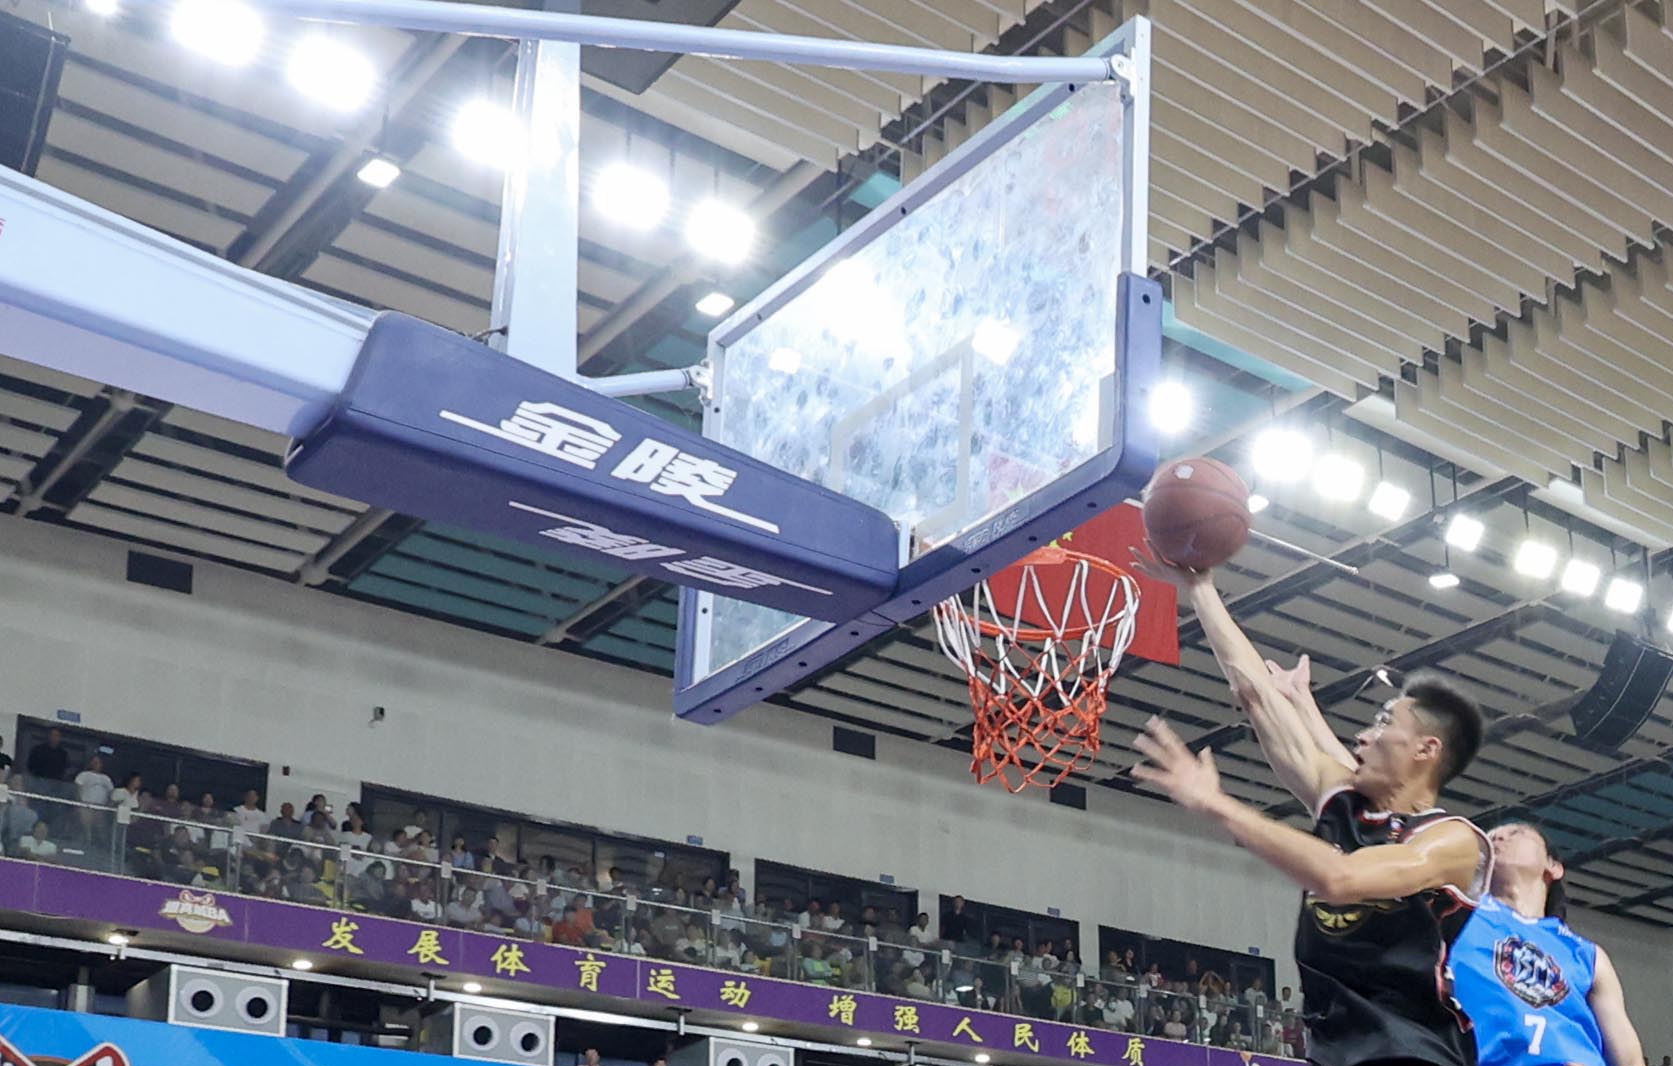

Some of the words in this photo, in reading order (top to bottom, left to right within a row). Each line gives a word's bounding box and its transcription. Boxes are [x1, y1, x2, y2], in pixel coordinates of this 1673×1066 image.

[322, 917, 753, 1009] 发展体育运动
[1524, 1013, 1546, 1055] 7
